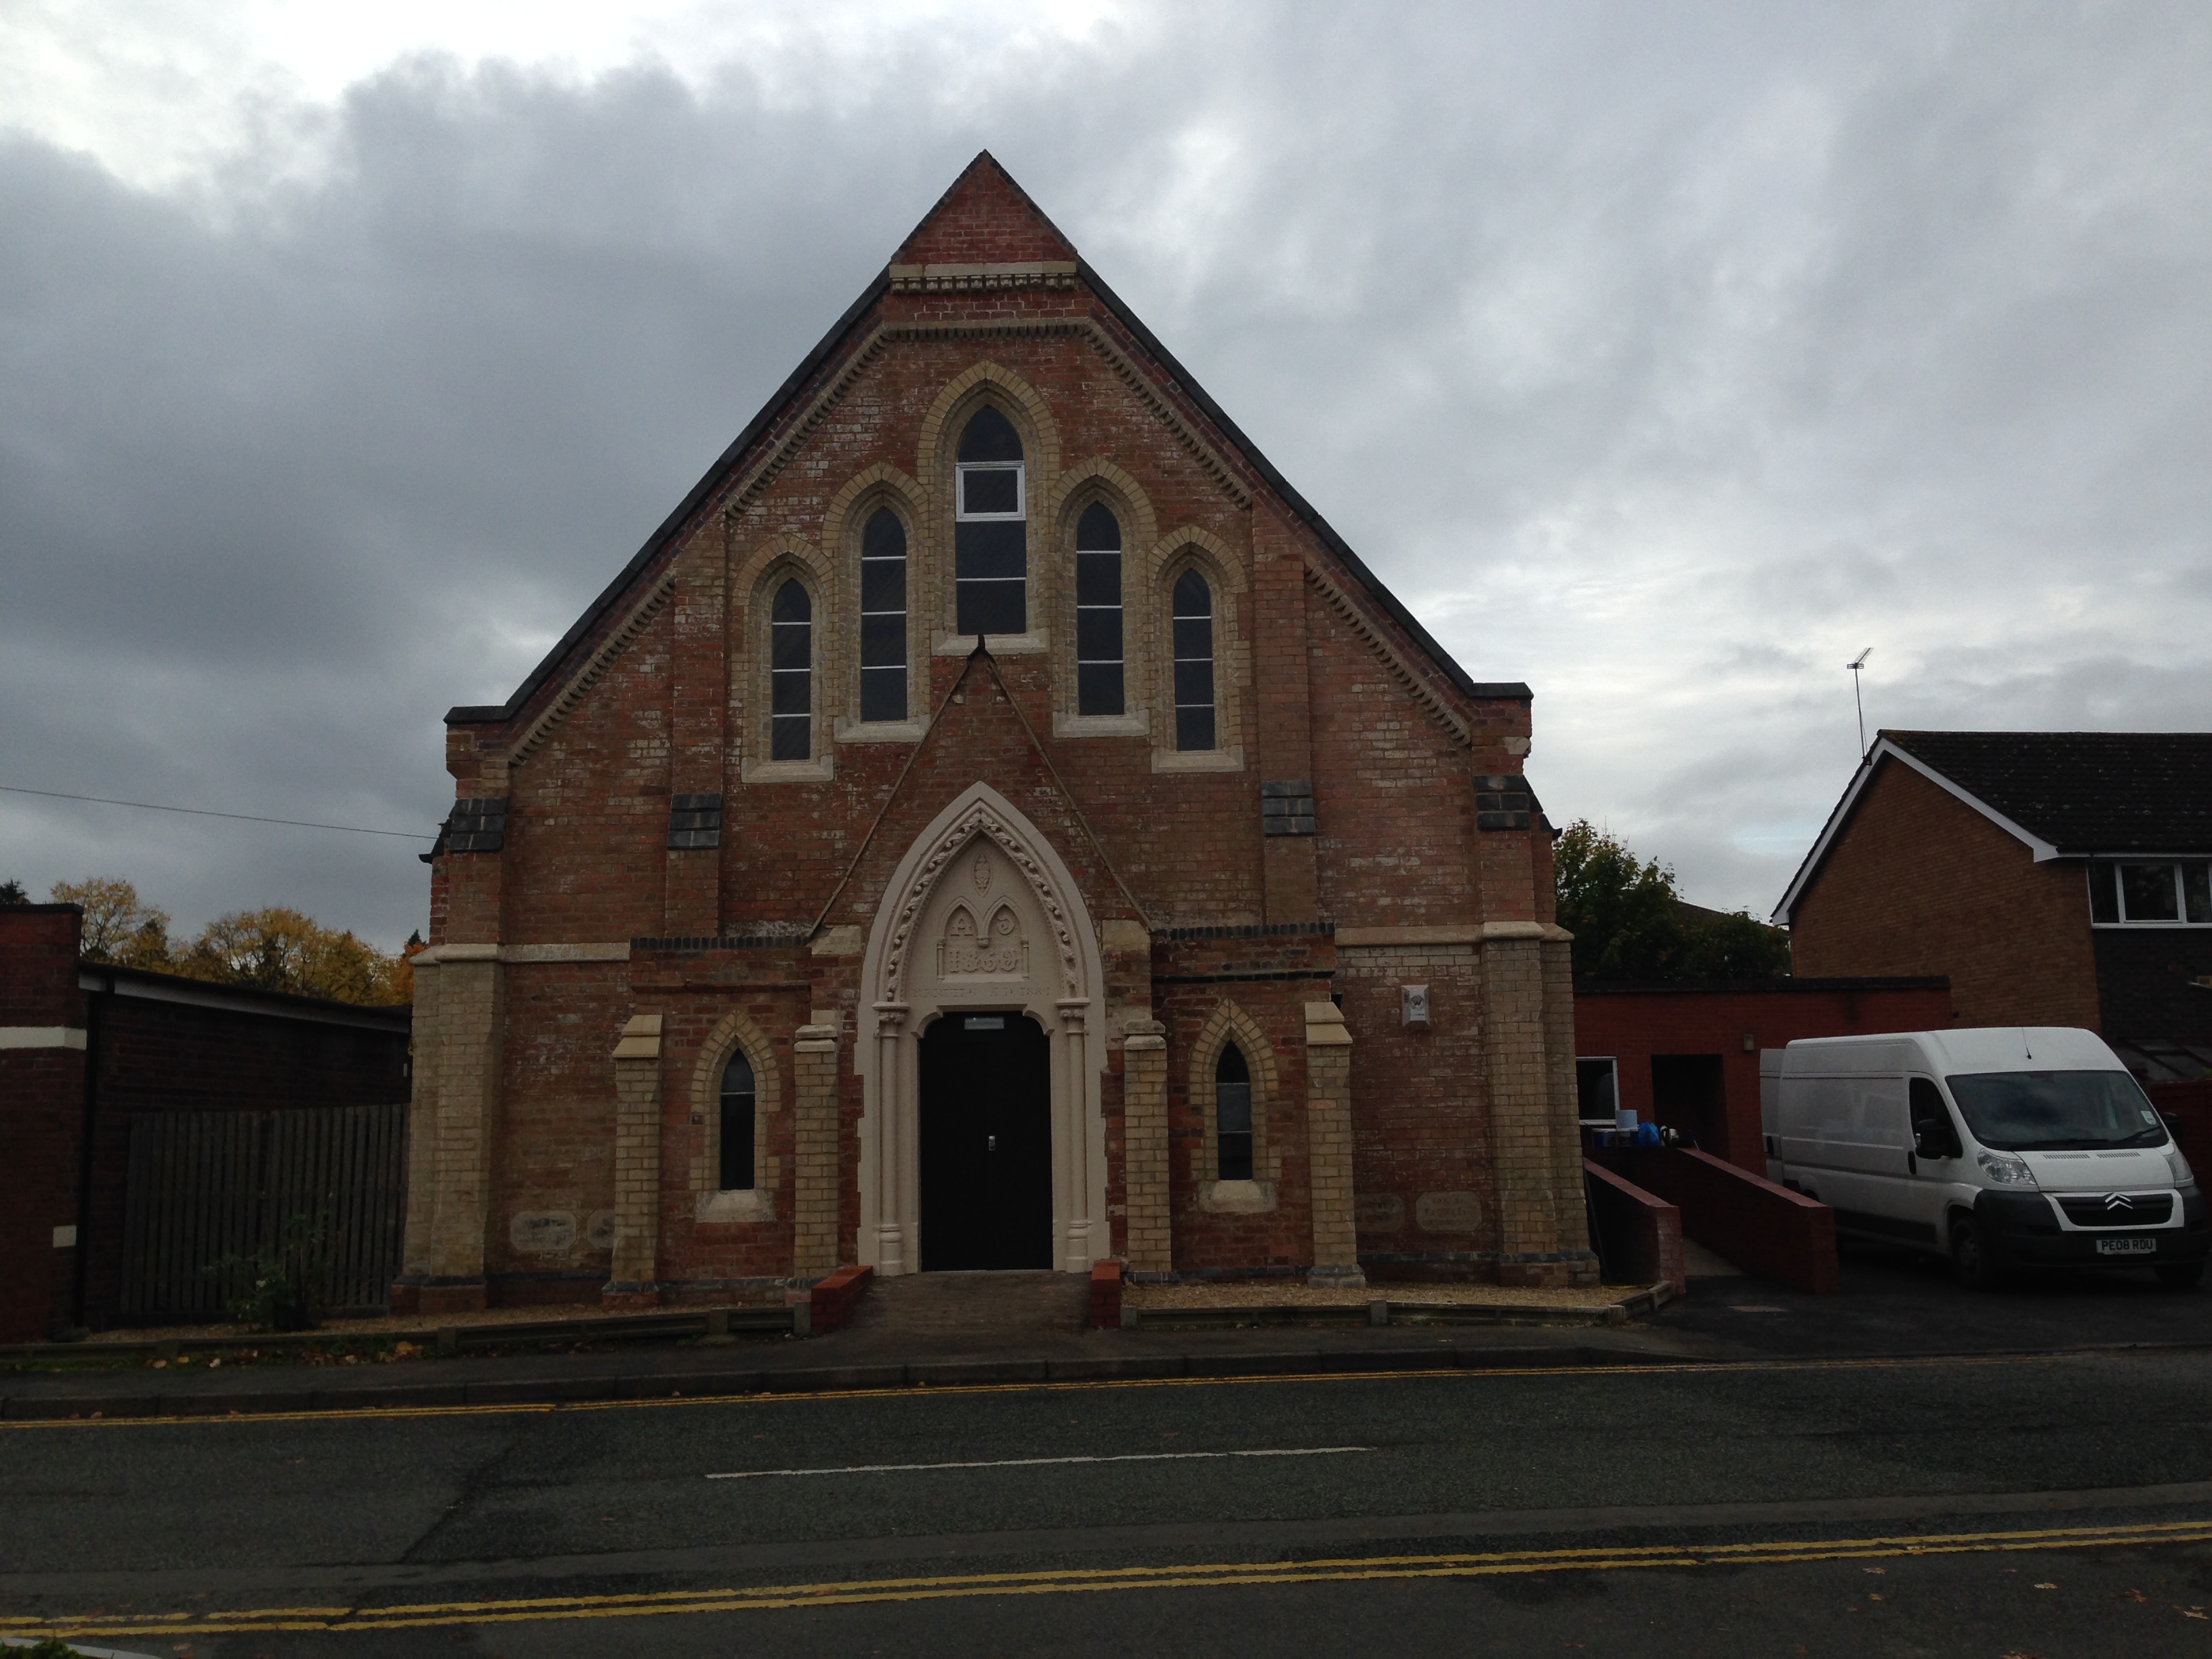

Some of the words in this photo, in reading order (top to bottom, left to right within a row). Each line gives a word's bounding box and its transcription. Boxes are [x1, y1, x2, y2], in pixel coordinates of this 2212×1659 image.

[950, 916, 973, 936] A
[2102, 1240, 2130, 1250] PE08
[2132, 1239, 2154, 1250] RDU
